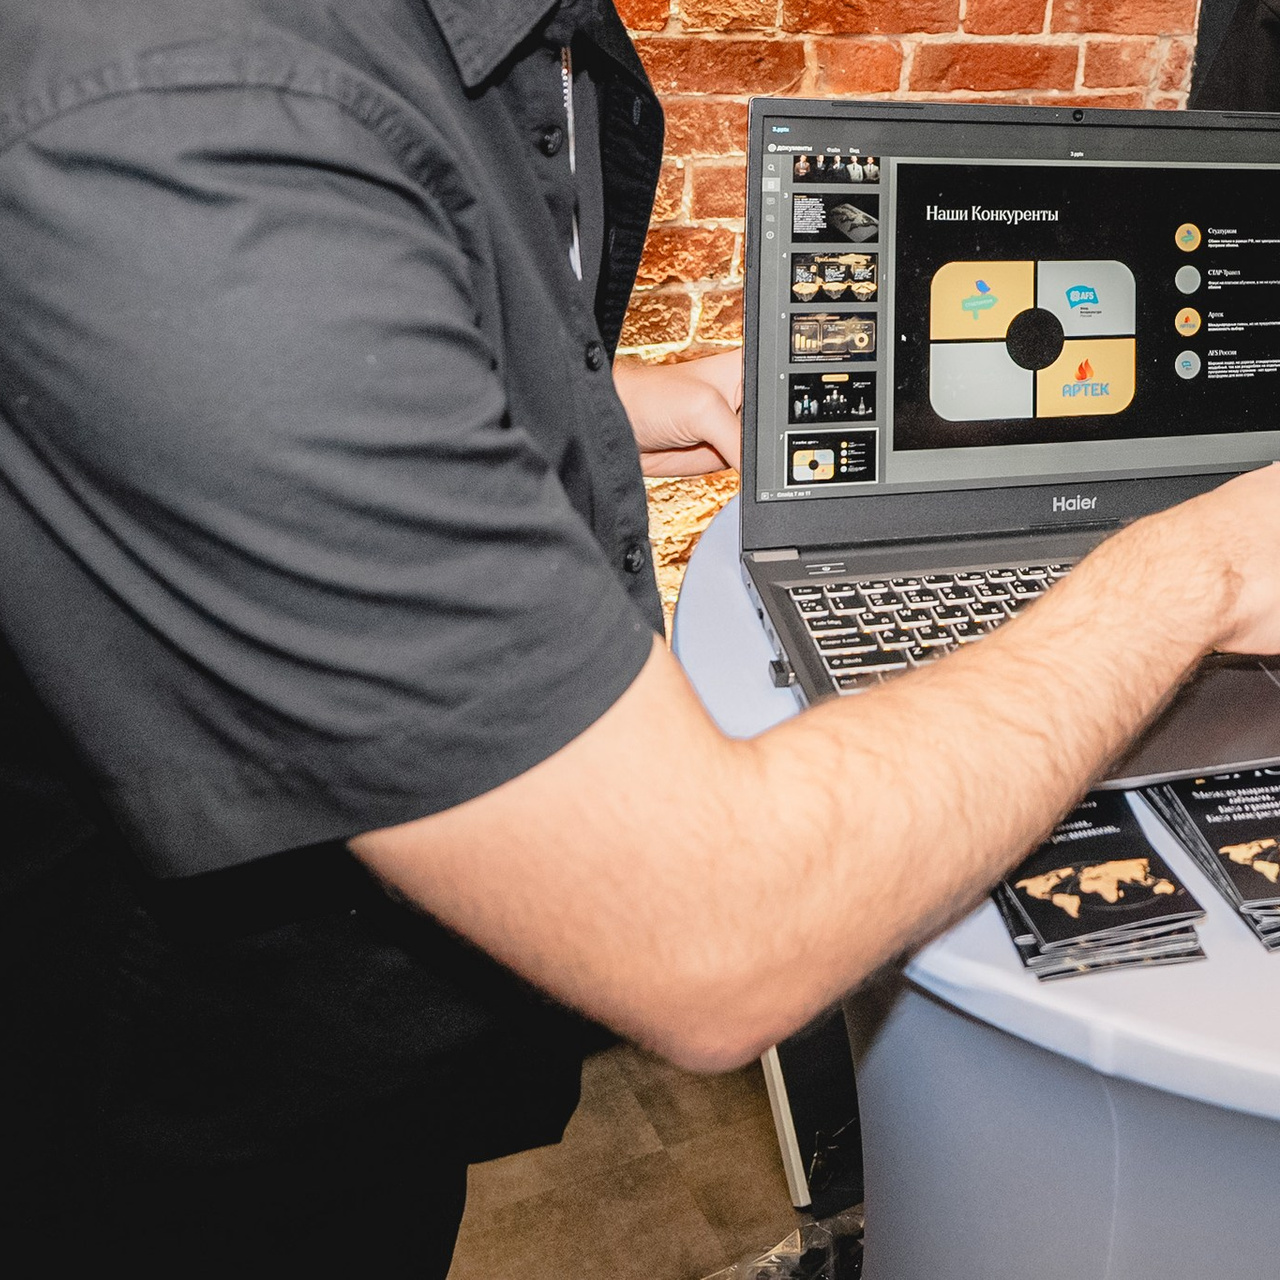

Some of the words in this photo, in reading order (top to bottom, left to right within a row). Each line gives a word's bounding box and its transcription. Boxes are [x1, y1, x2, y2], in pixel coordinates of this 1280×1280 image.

[926, 205, 969, 221] Наши
[971, 205, 1059, 225] Конкуренты
[1062, 382, 1110, 398] АРТЕК
[1052, 496, 1097, 512] Haier
